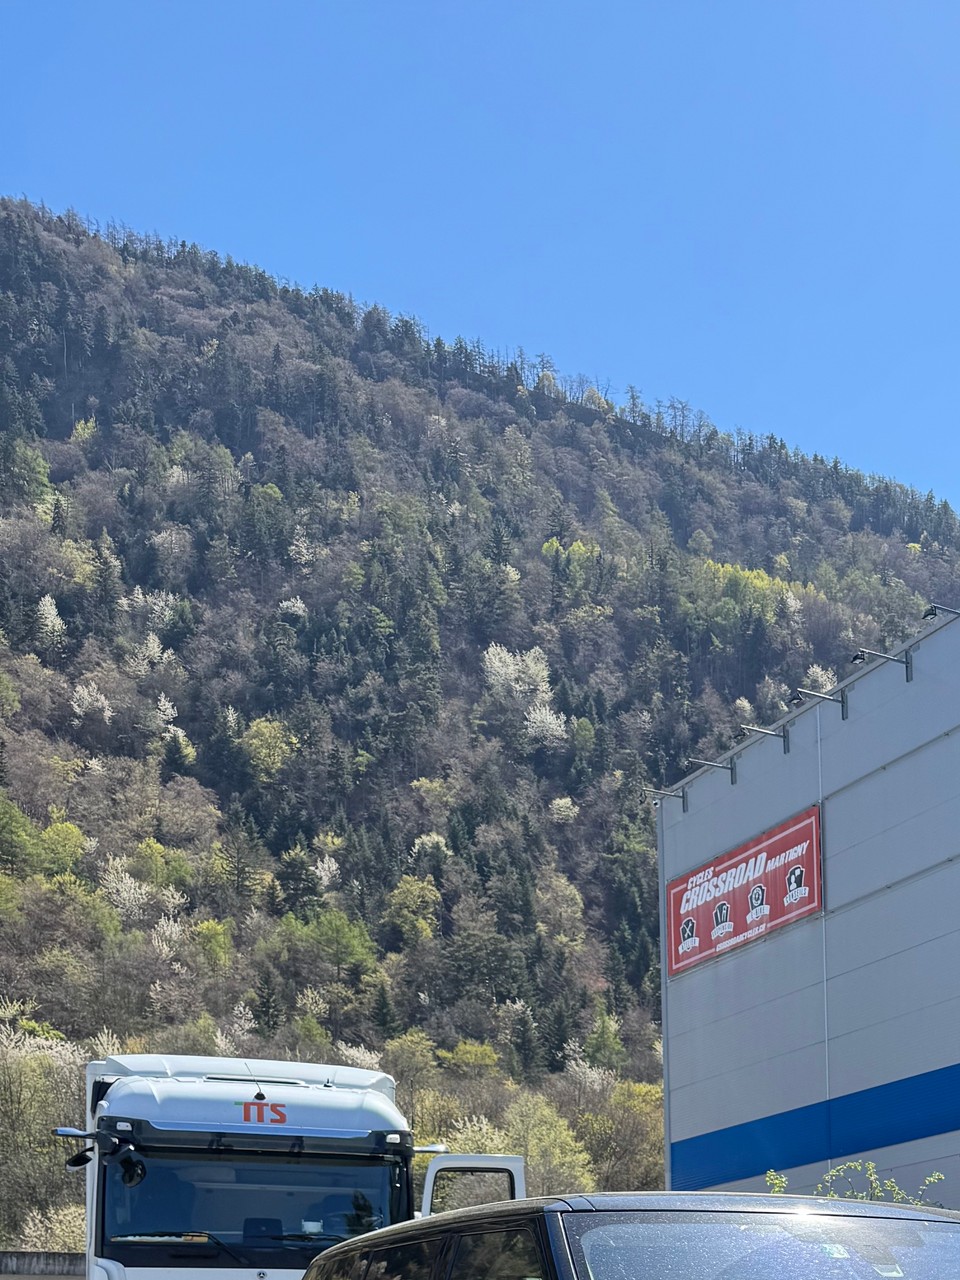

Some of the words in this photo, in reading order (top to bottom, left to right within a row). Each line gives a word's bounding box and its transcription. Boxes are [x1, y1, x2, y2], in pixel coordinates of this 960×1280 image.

[680, 852, 767, 914] CROSSROAD
[766, 840, 810, 873] MARTIGNY
[687, 866, 714, 889] CYCLES
